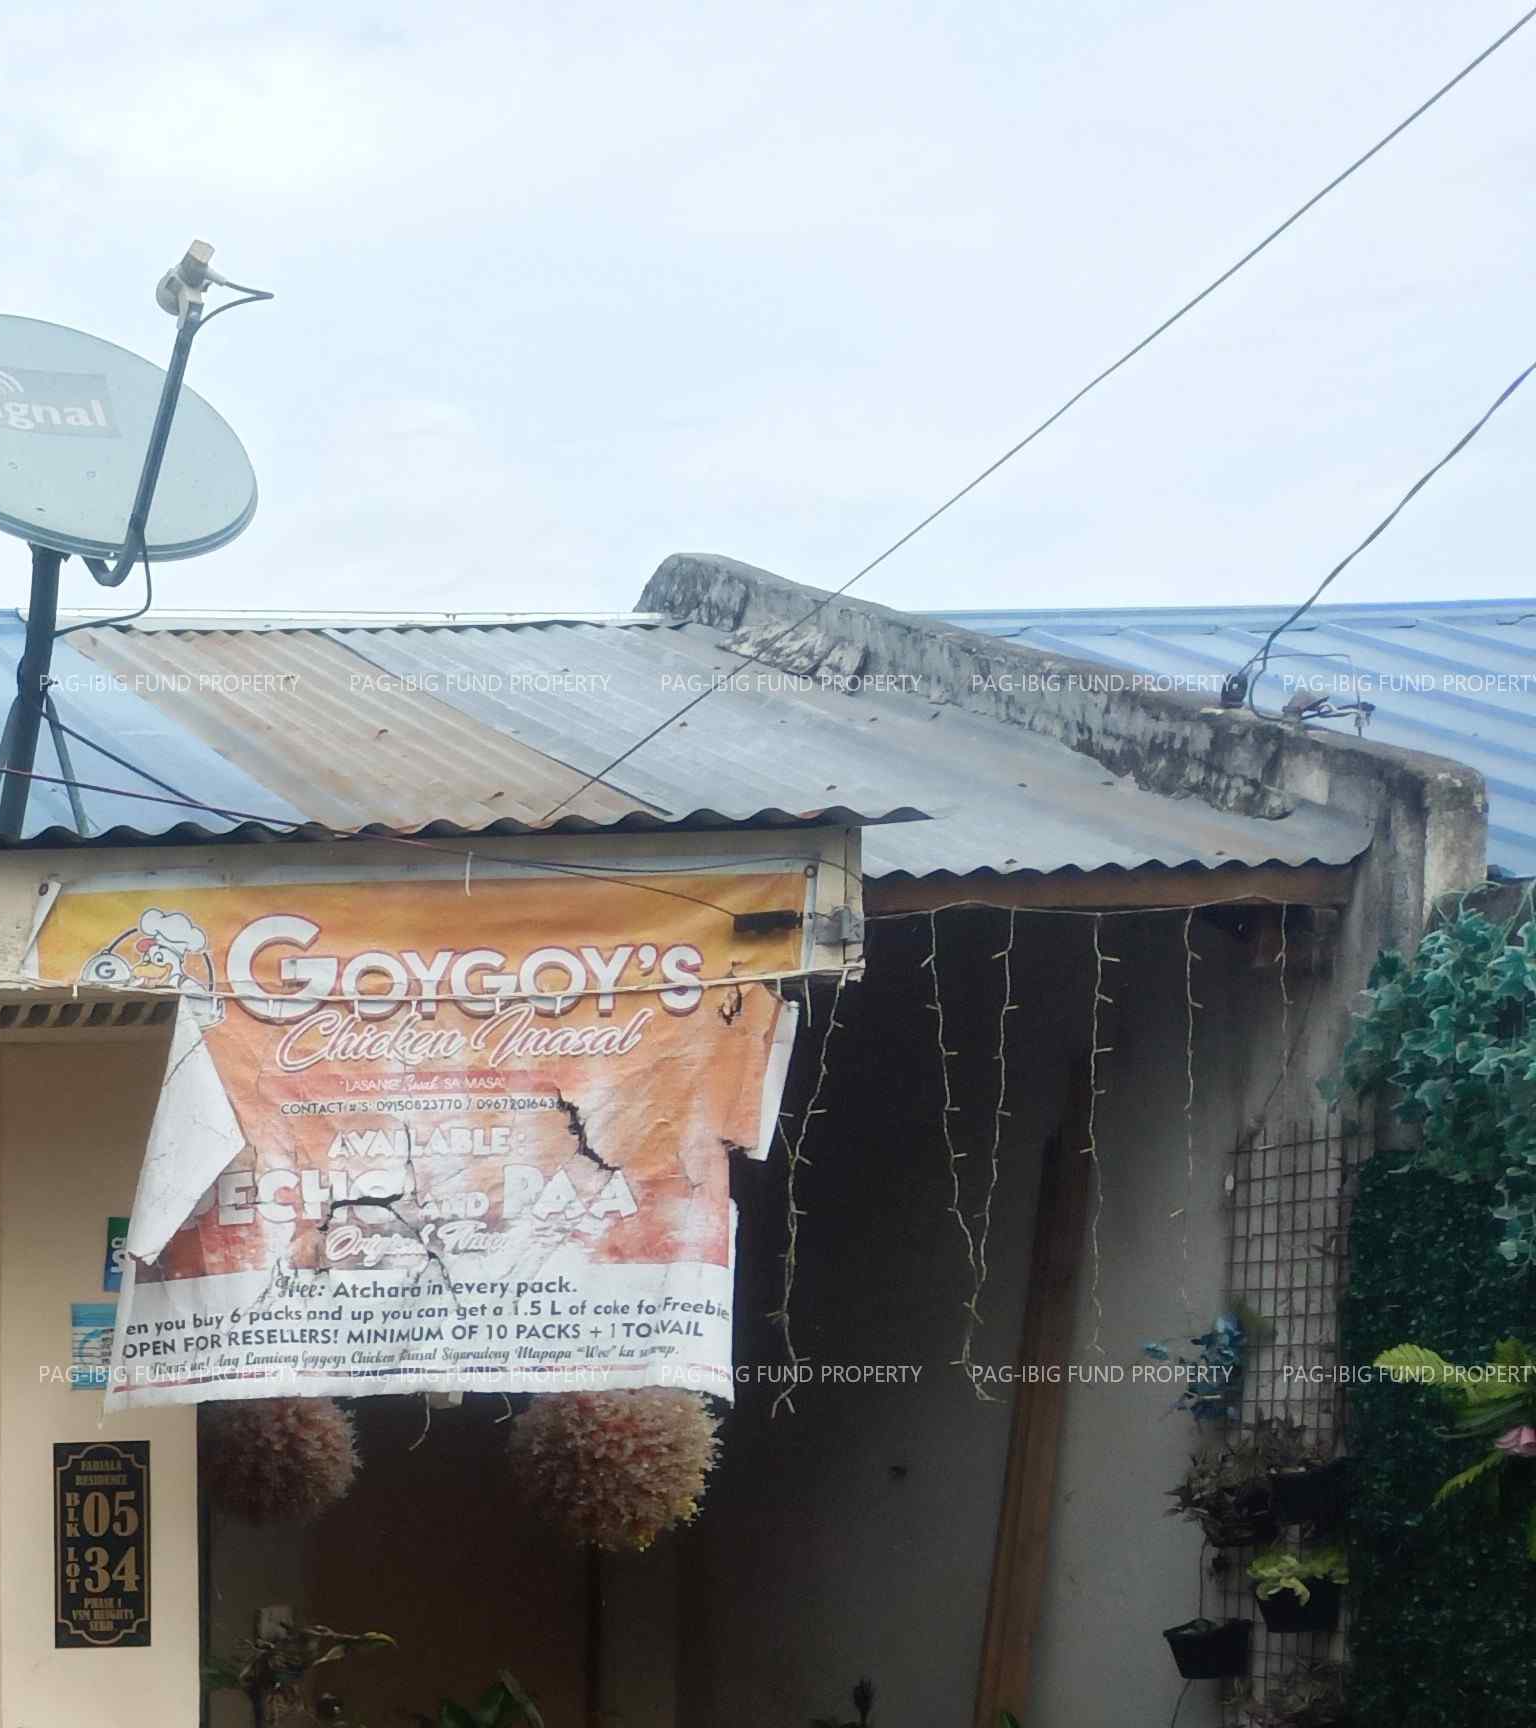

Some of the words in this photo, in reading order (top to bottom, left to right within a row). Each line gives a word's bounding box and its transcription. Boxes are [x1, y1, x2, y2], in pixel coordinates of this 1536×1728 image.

[276, 1009, 464, 1072] Chicken
[473, 1003, 653, 1067] Inasal
[280, 1101, 344, 1115] CONTACT
[333, 1281, 422, 1299] Atchara
[427, 1280, 443, 1296] in
[451, 1279, 510, 1299] every
[516, 1276, 577, 1298] pack.
[154, 1319, 186, 1336] you
[193, 1312, 224, 1330] buy
[230, 1307, 242, 1325] 6
[249, 1305, 302, 1325] packs
[307, 1304, 343, 1321] and
[351, 1308, 375, 1324] up
[381, 1307, 413, 1326] you
[417, 1305, 449, 1319] can
[455, 1302, 490, 1320] get
[493, 1305, 504, 1317] a
[512, 1300, 542, 1317] 1.5
[550, 1300, 563, 1316] L
[568, 1299, 588, 1316] of
[593, 1299, 630, 1316] coke
[122, 1339, 176, 1359] OPEN
[183, 1334, 221, 1353] FOR
[228, 1328, 339, 1347] RESELLERS!
[346, 1326, 444, 1345] MINIMUM
[451, 1325, 479, 1341] OF
[486, 1324, 508, 1339] 10
[515, 1323, 581, 1340] PACKS
[622, 1322, 652, 1338] TO
[351, 1350, 396, 1365] Chicken
[82, 1490, 140, 1537] 05
[83, 1546, 141, 1593] 34
